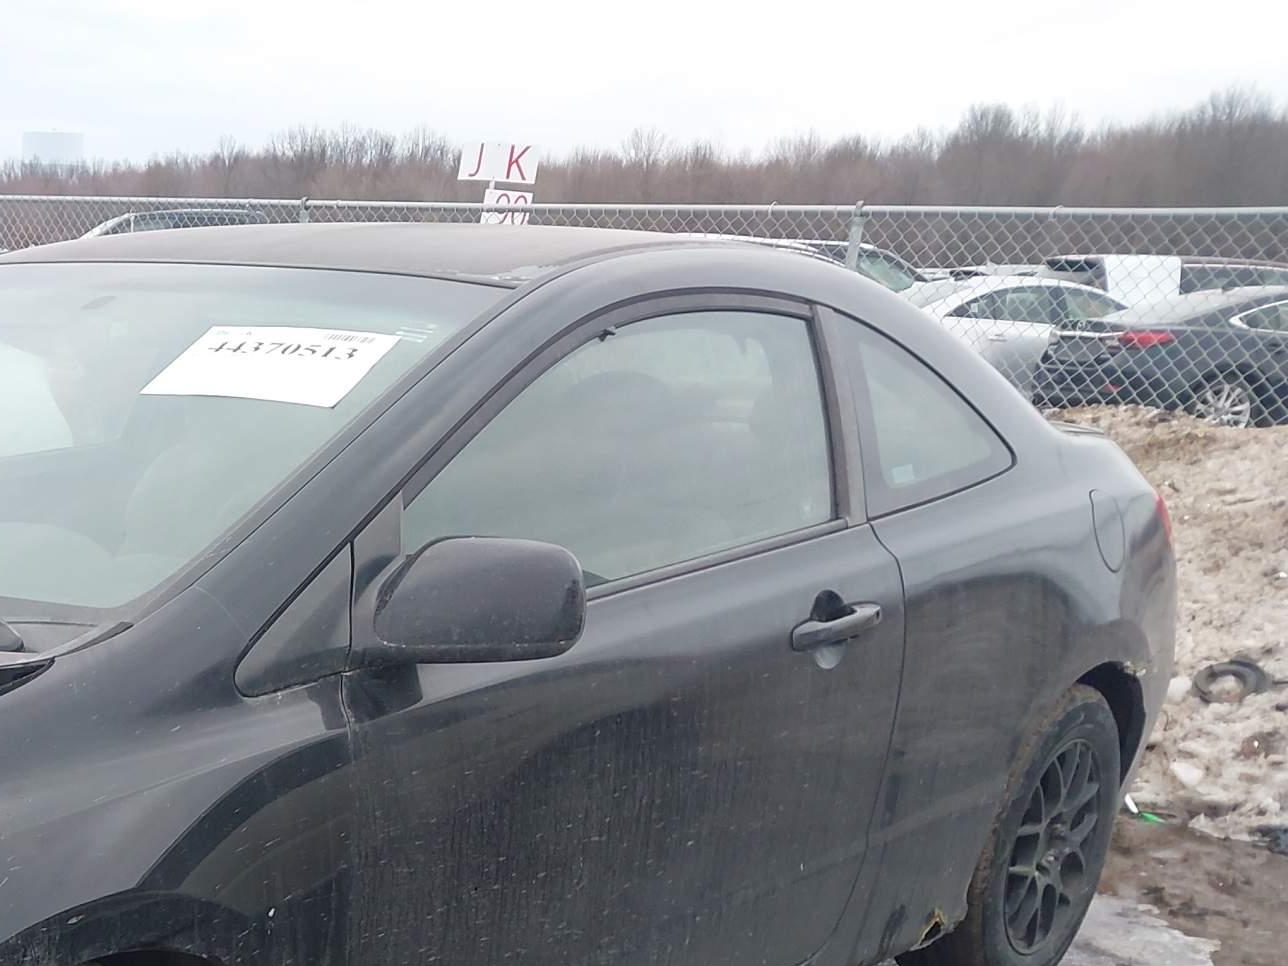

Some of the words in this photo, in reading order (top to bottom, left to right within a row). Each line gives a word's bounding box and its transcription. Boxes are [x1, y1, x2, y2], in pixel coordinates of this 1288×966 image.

[467, 142, 485, 178] J
[504, 143, 533, 181] K
[208, 341, 359, 360] 44370513
